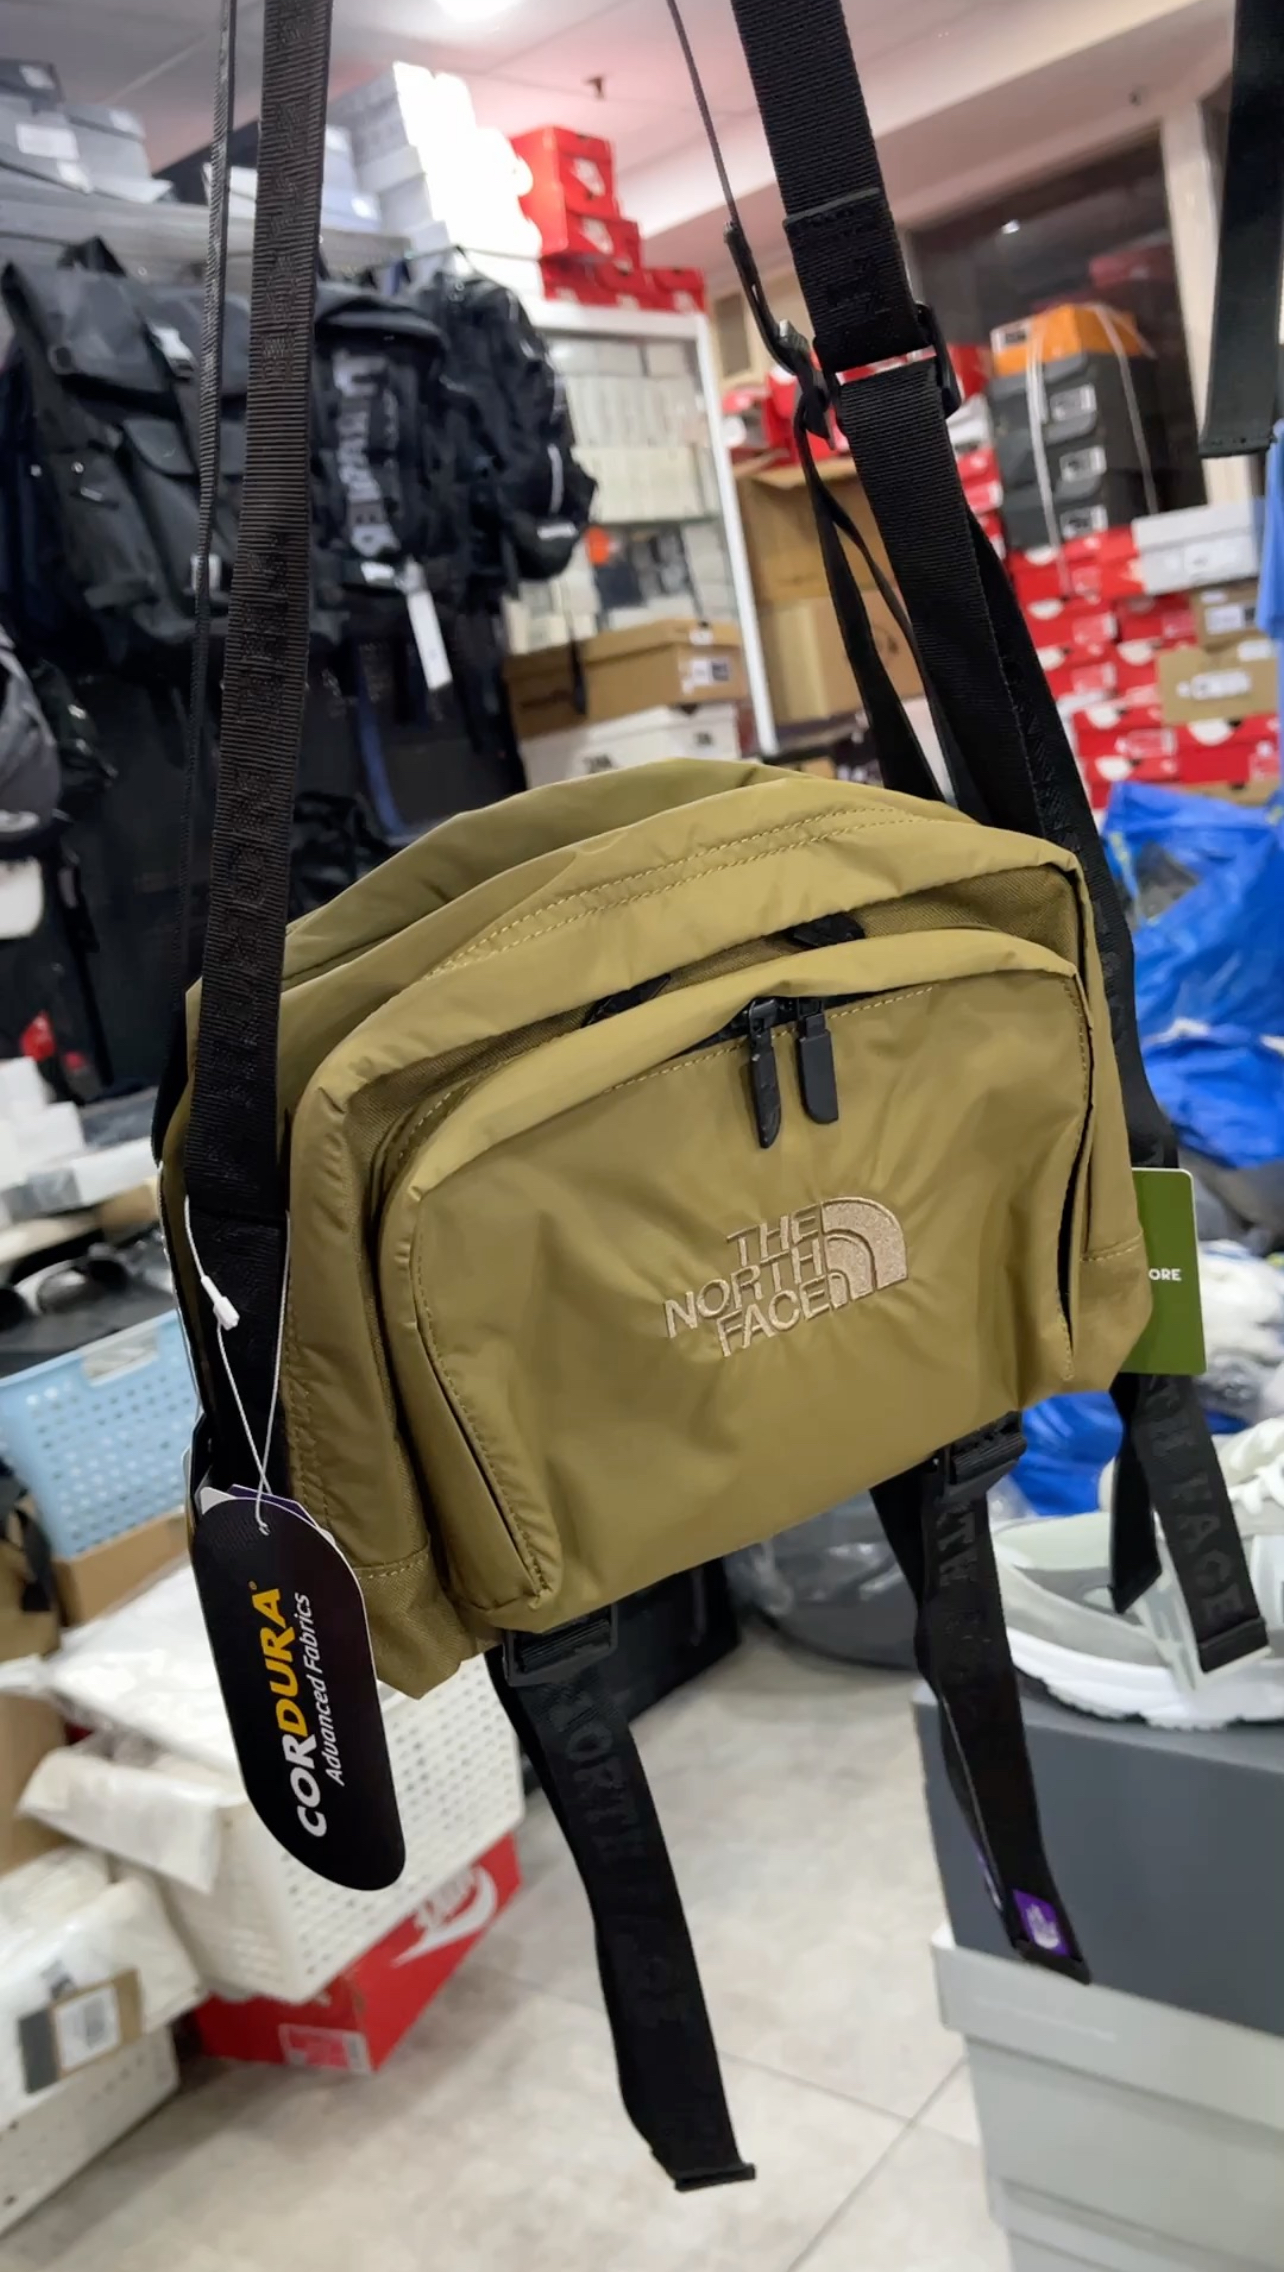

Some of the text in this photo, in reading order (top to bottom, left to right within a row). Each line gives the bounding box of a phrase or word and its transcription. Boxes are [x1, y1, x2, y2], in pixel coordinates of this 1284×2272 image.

[726, 1204, 819, 1268] THE
[664, 1239, 823, 1339] NORTH
[715, 1275, 832, 1357] FACE
[294, 1592, 324, 1673] Fabrics
